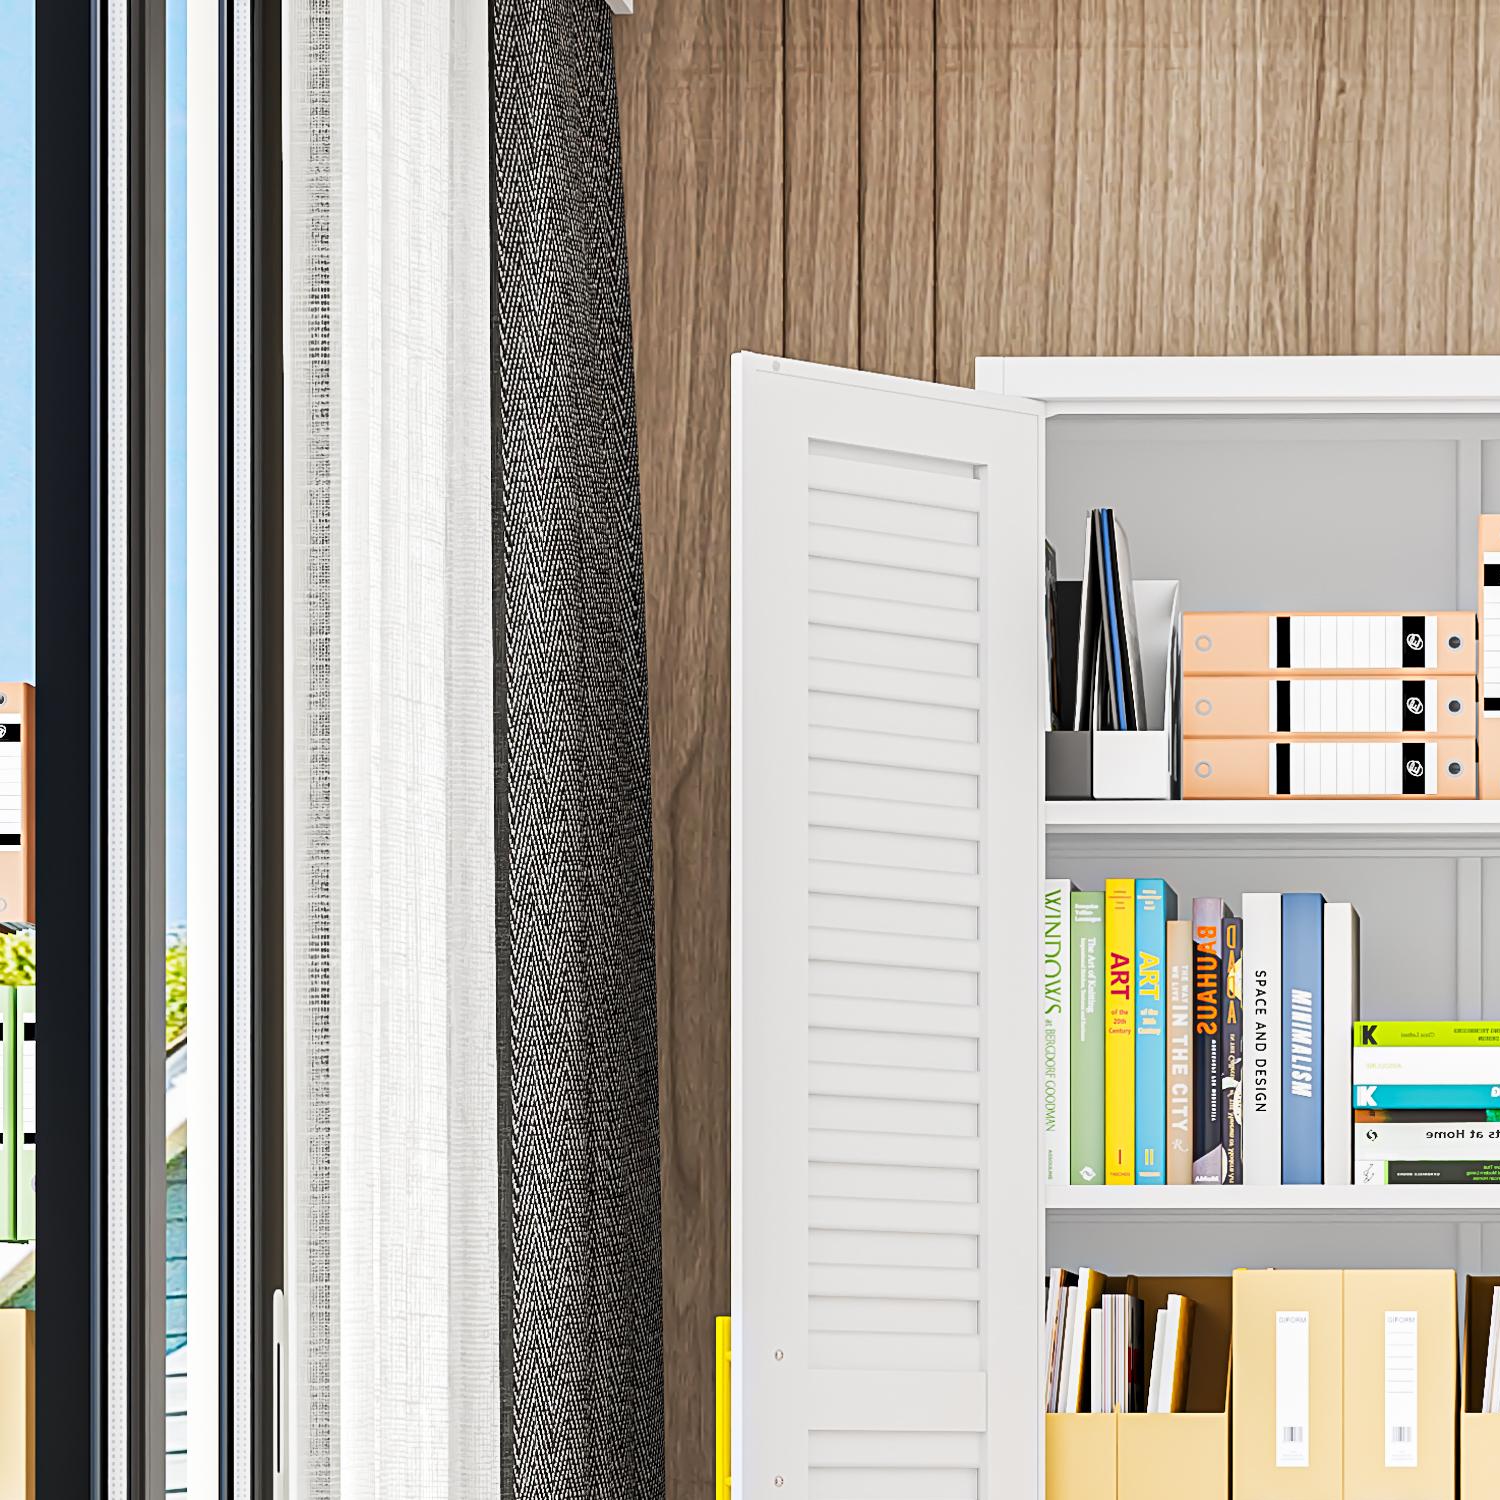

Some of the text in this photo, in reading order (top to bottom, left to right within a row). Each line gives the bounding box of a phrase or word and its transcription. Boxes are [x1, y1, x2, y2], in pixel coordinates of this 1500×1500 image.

[1044, 888, 1062, 1014] WINDOWS
[1086, 937, 1097, 953] The
[1086, 954, 1097, 969] Art
[1086, 970, 1097, 979] of
[1086, 980, 1097, 1014] Knitting
[1110, 952, 1130, 1000] ART
[1138, 950, 1160, 1000] ART
[1044, 1028, 1056, 1078] BERGDORF
[1254, 970, 1267, 1112] SPACE AND DESIGN
[1290, 988, 1313, 1098] MINIMALISM
[1172, 1004, 1189, 1132] IN THE CITY
[1044, 1080, 1056, 1132] GOODMAN
